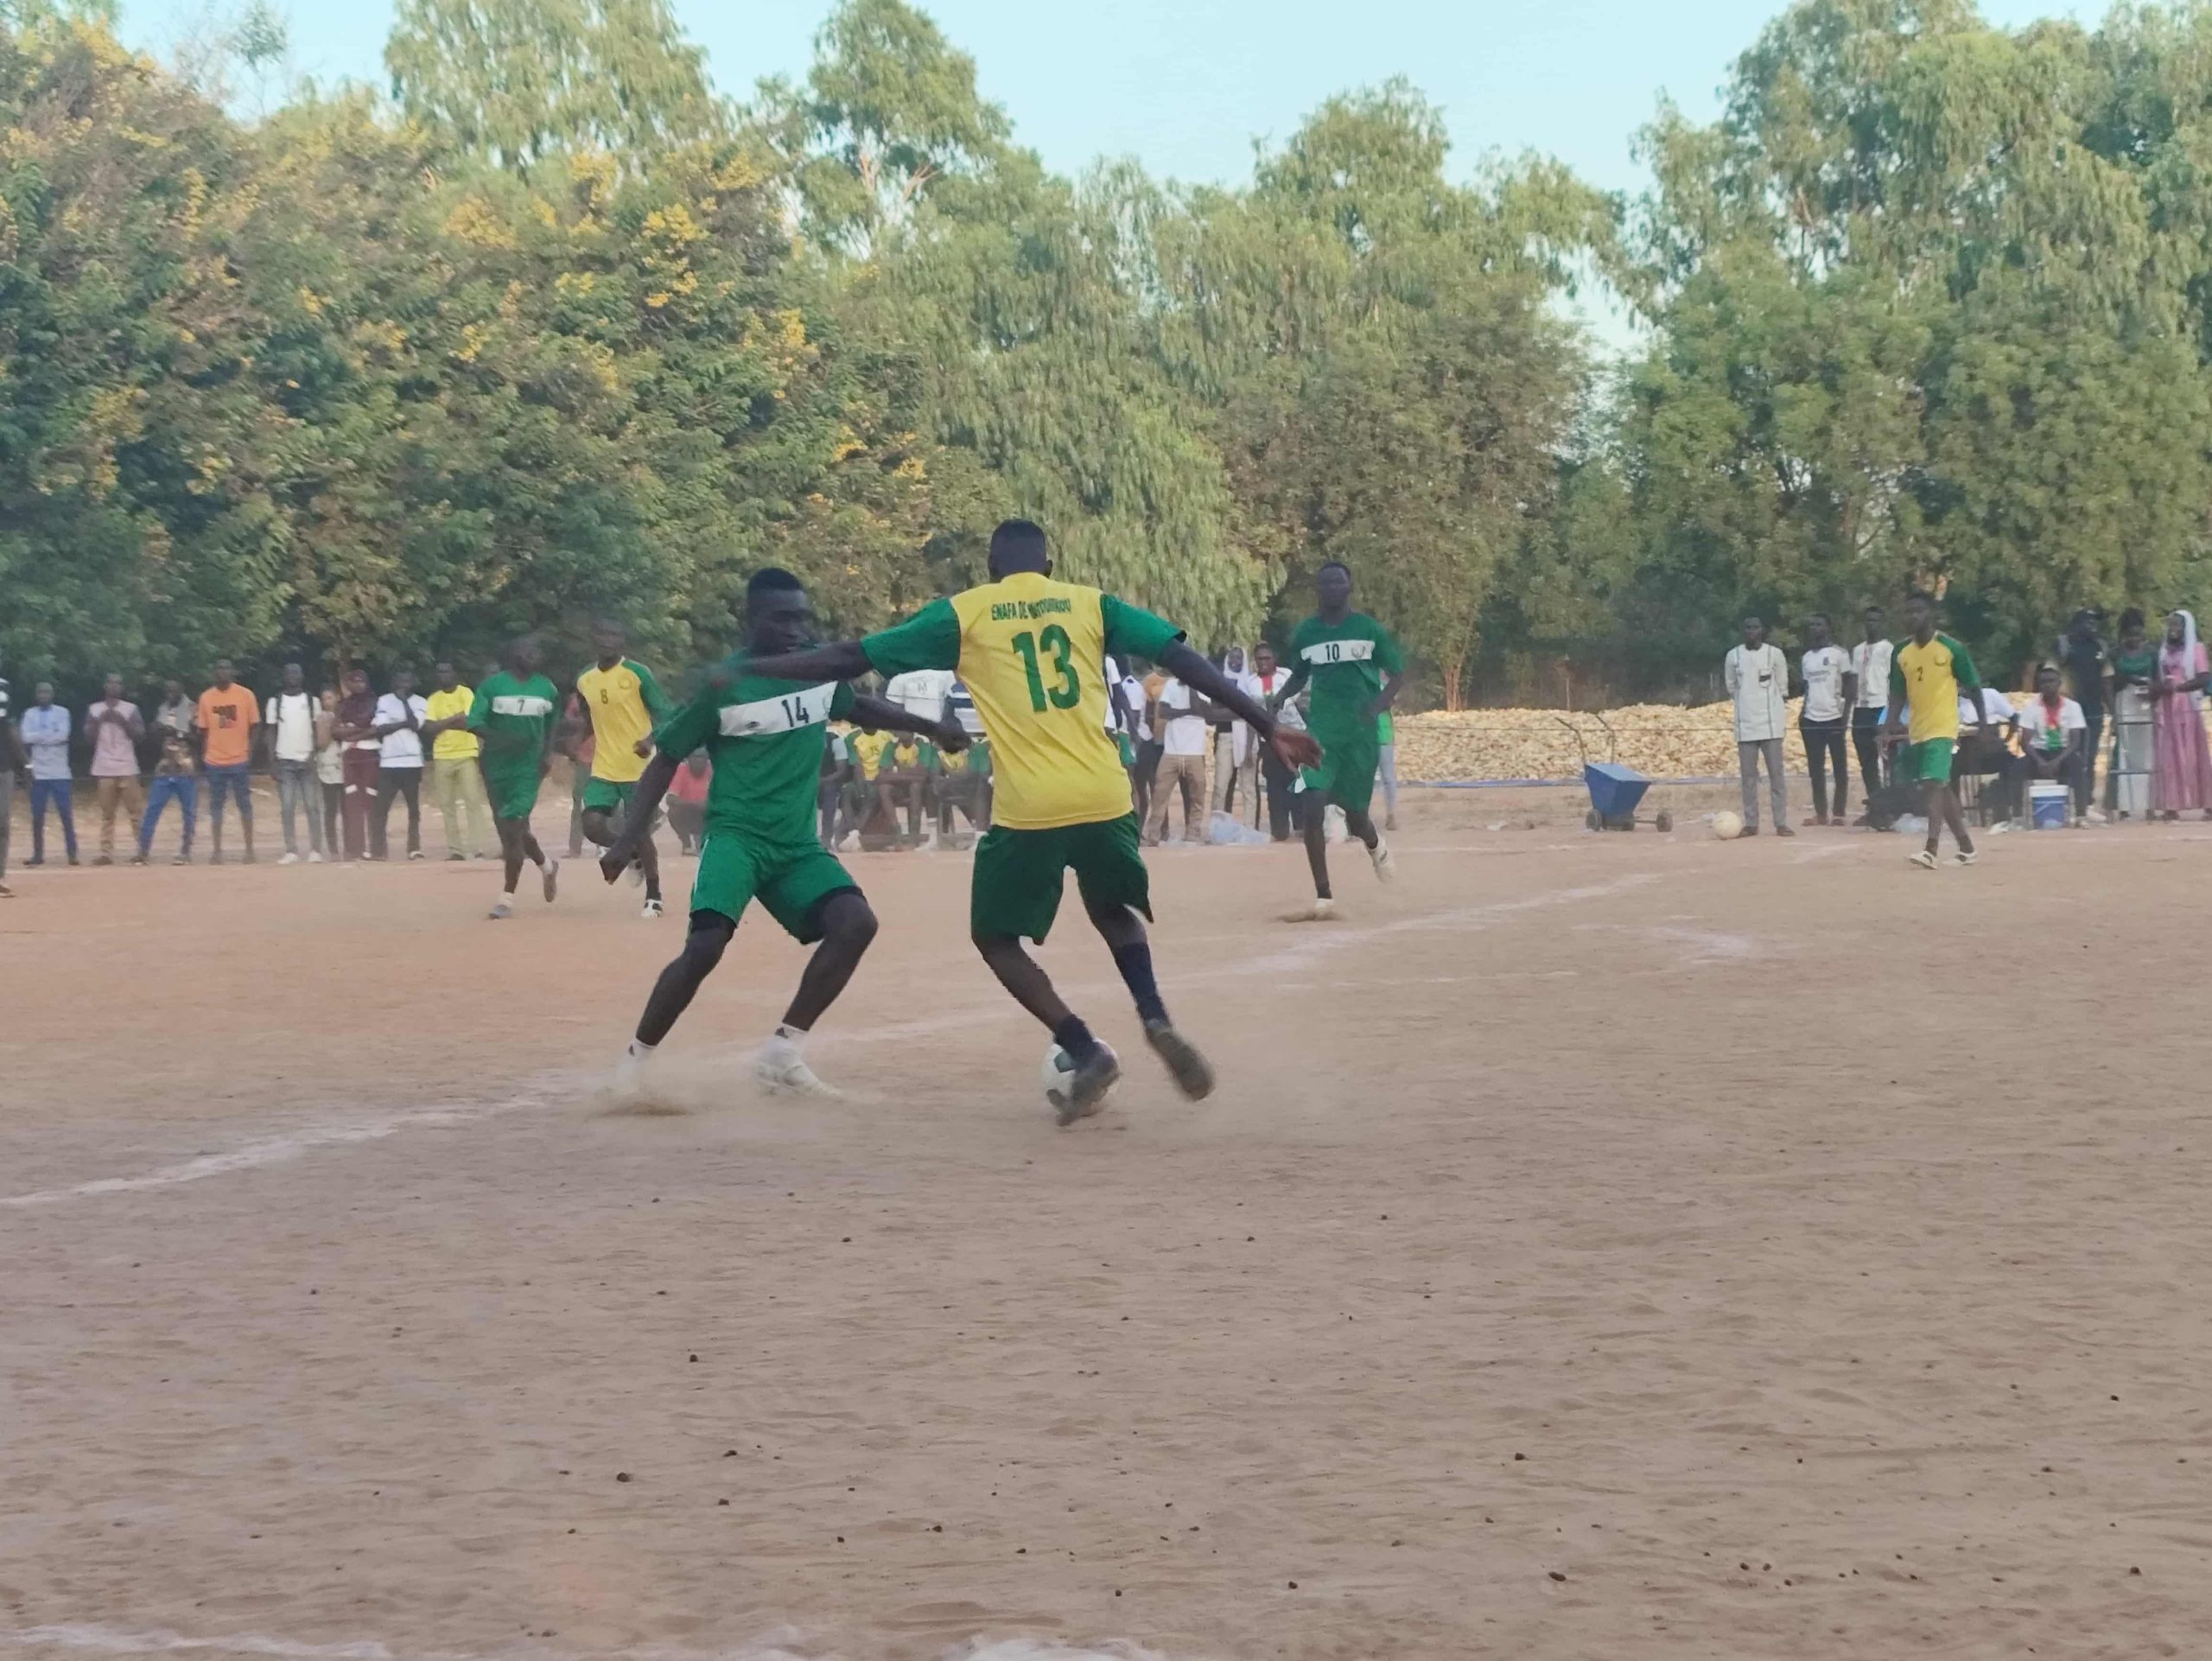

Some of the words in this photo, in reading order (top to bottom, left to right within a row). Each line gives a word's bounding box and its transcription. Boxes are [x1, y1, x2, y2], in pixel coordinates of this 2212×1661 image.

[1325, 644, 1339, 662] 10
[1012, 624, 1080, 712] 13
[517, 698, 525, 713] 7
[781, 697, 810, 727] 14
